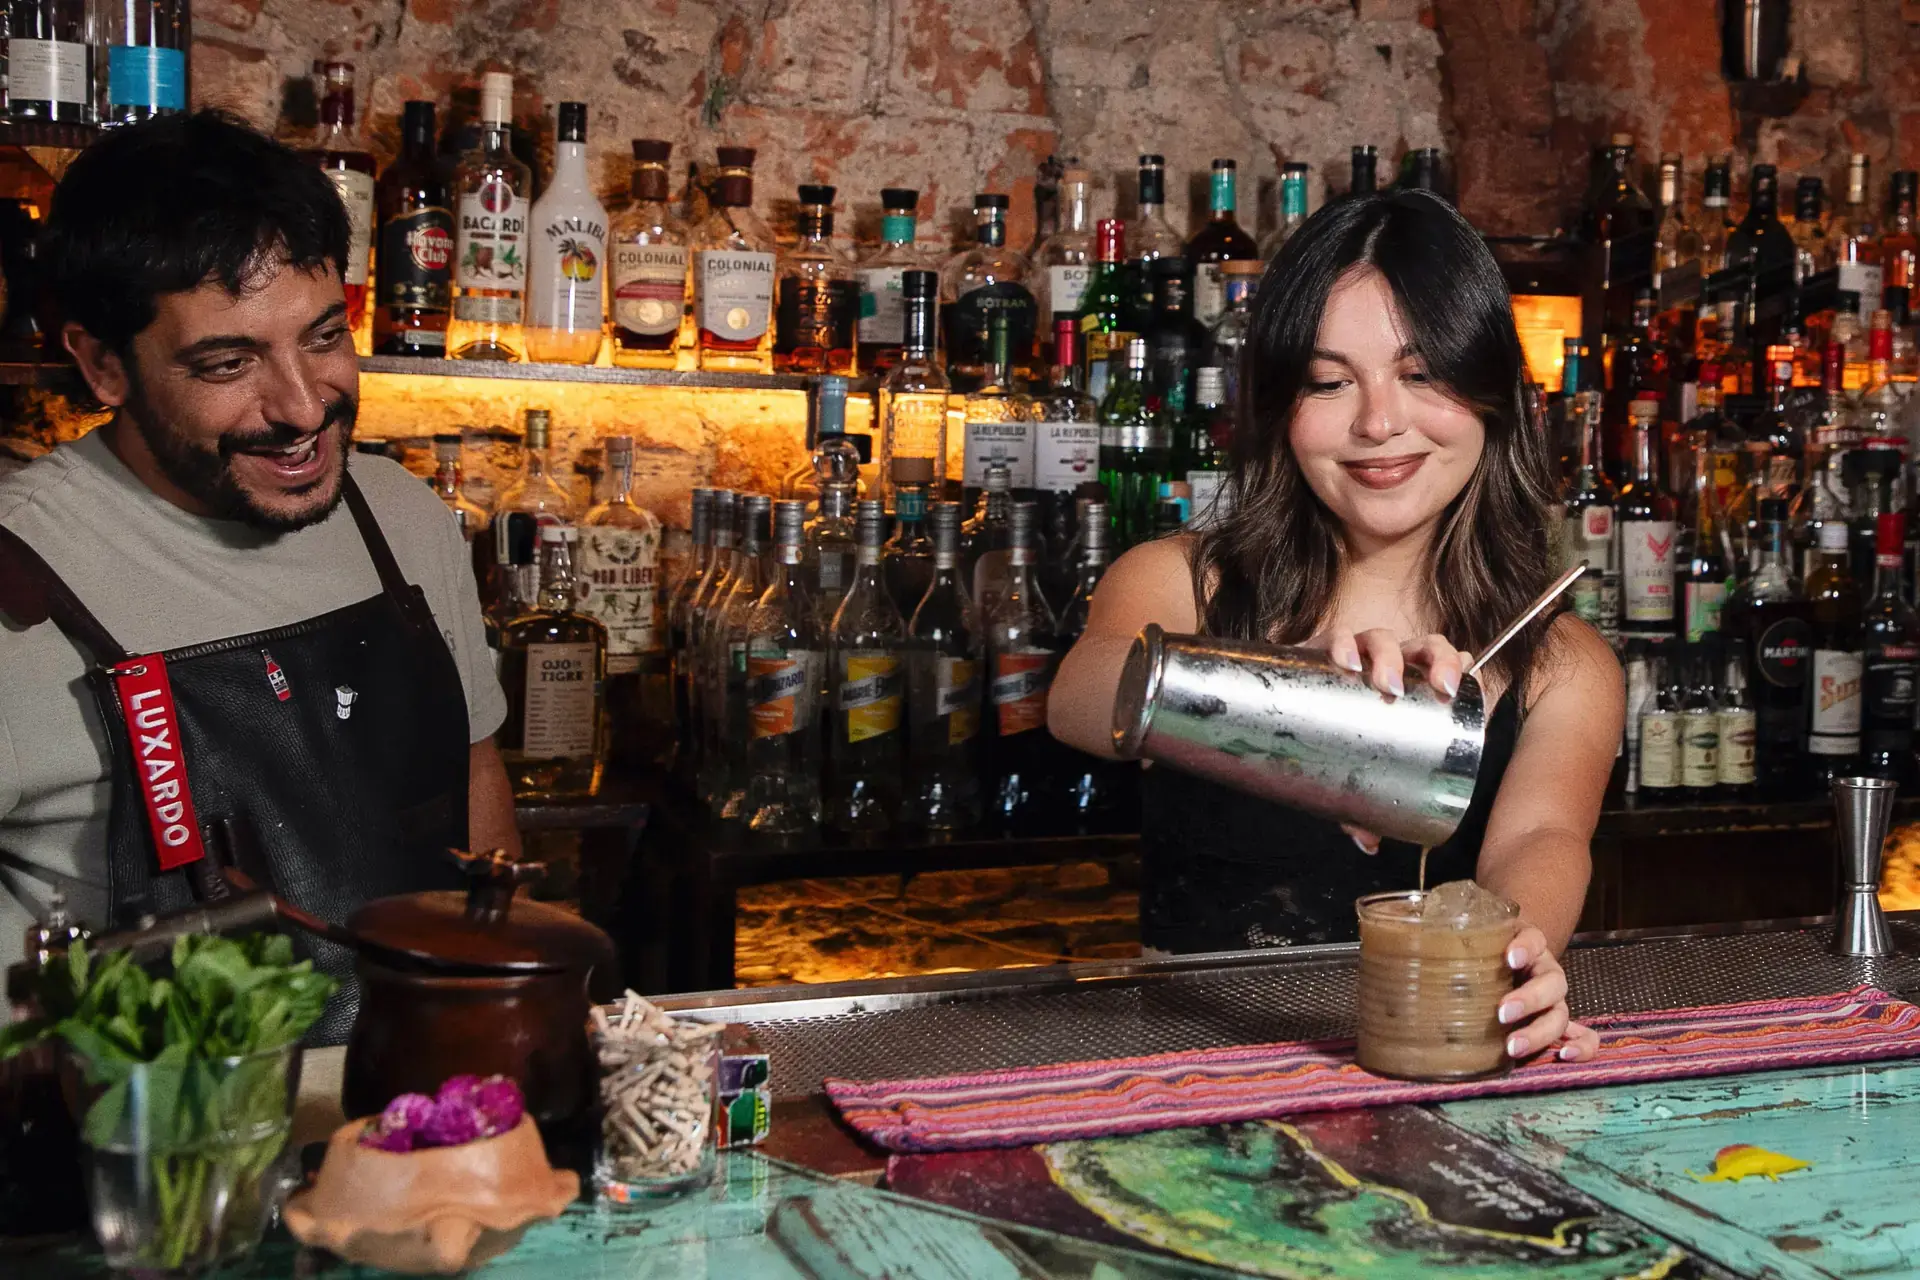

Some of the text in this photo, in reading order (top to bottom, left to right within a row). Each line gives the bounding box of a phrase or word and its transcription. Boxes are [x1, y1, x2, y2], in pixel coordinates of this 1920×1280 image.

[417, 247, 448, 264] Club
[618, 251, 685, 265] COLONIAL
[707, 259, 772, 272] COLONIAL
[542, 660, 572, 670] OJO
[541, 671, 584, 681] TIGRE
[130, 688, 190, 847] LUXARDO
